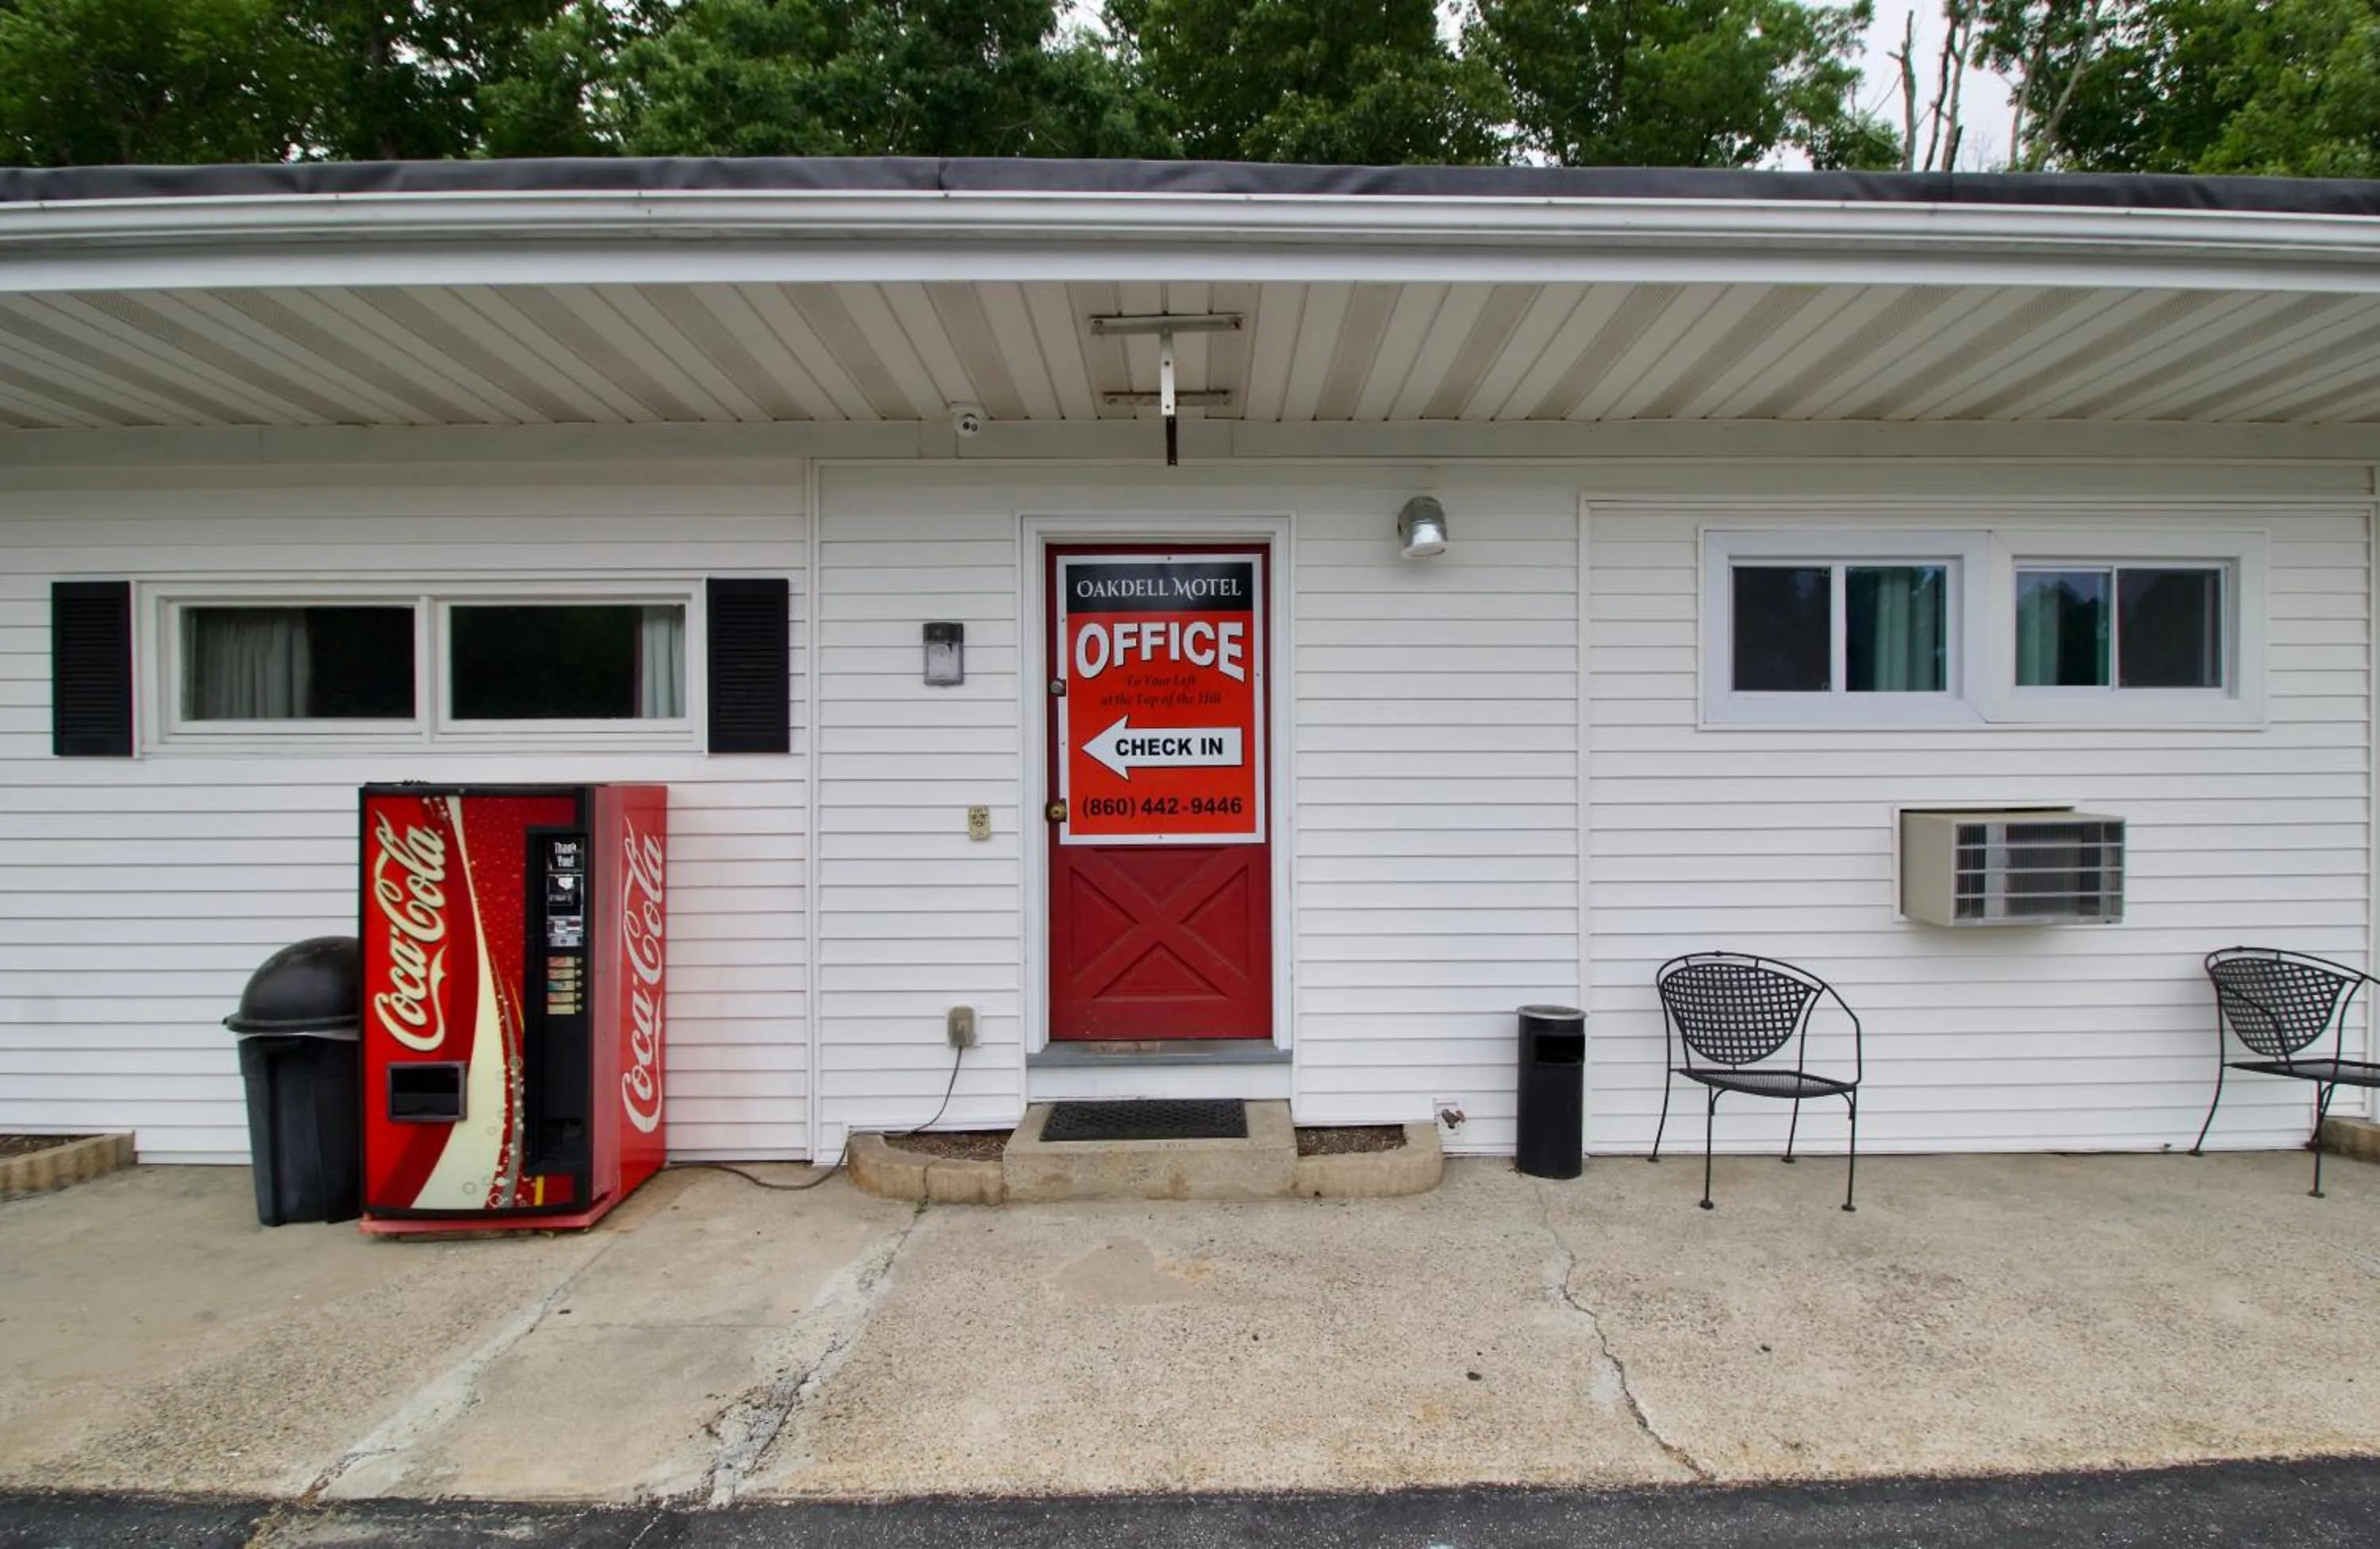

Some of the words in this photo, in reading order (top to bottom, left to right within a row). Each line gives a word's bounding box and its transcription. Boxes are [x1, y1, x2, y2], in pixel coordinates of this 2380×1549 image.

[1077, 579, 1169, 597] OAKDELL
[1172, 578, 1242, 600] MOTEL
[1075, 621, 1245, 682] OFFICE
[1127, 675, 1141, 686] To
[1143, 675, 1170, 686] Your
[1174, 675, 1196, 688] Left
[1115, 693, 1131, 705] the
[1136, 693, 1159, 708] Top
[1161, 693, 1175, 708] of
[1177, 693, 1195, 705] the
[1198, 691, 1222, 705] Hill
[1115, 737, 1192, 756] CHECK
[1200, 738, 1223, 755] IN
[1082, 797, 1136, 818] (860)
[1140, 797, 1243, 815] 442-9446
